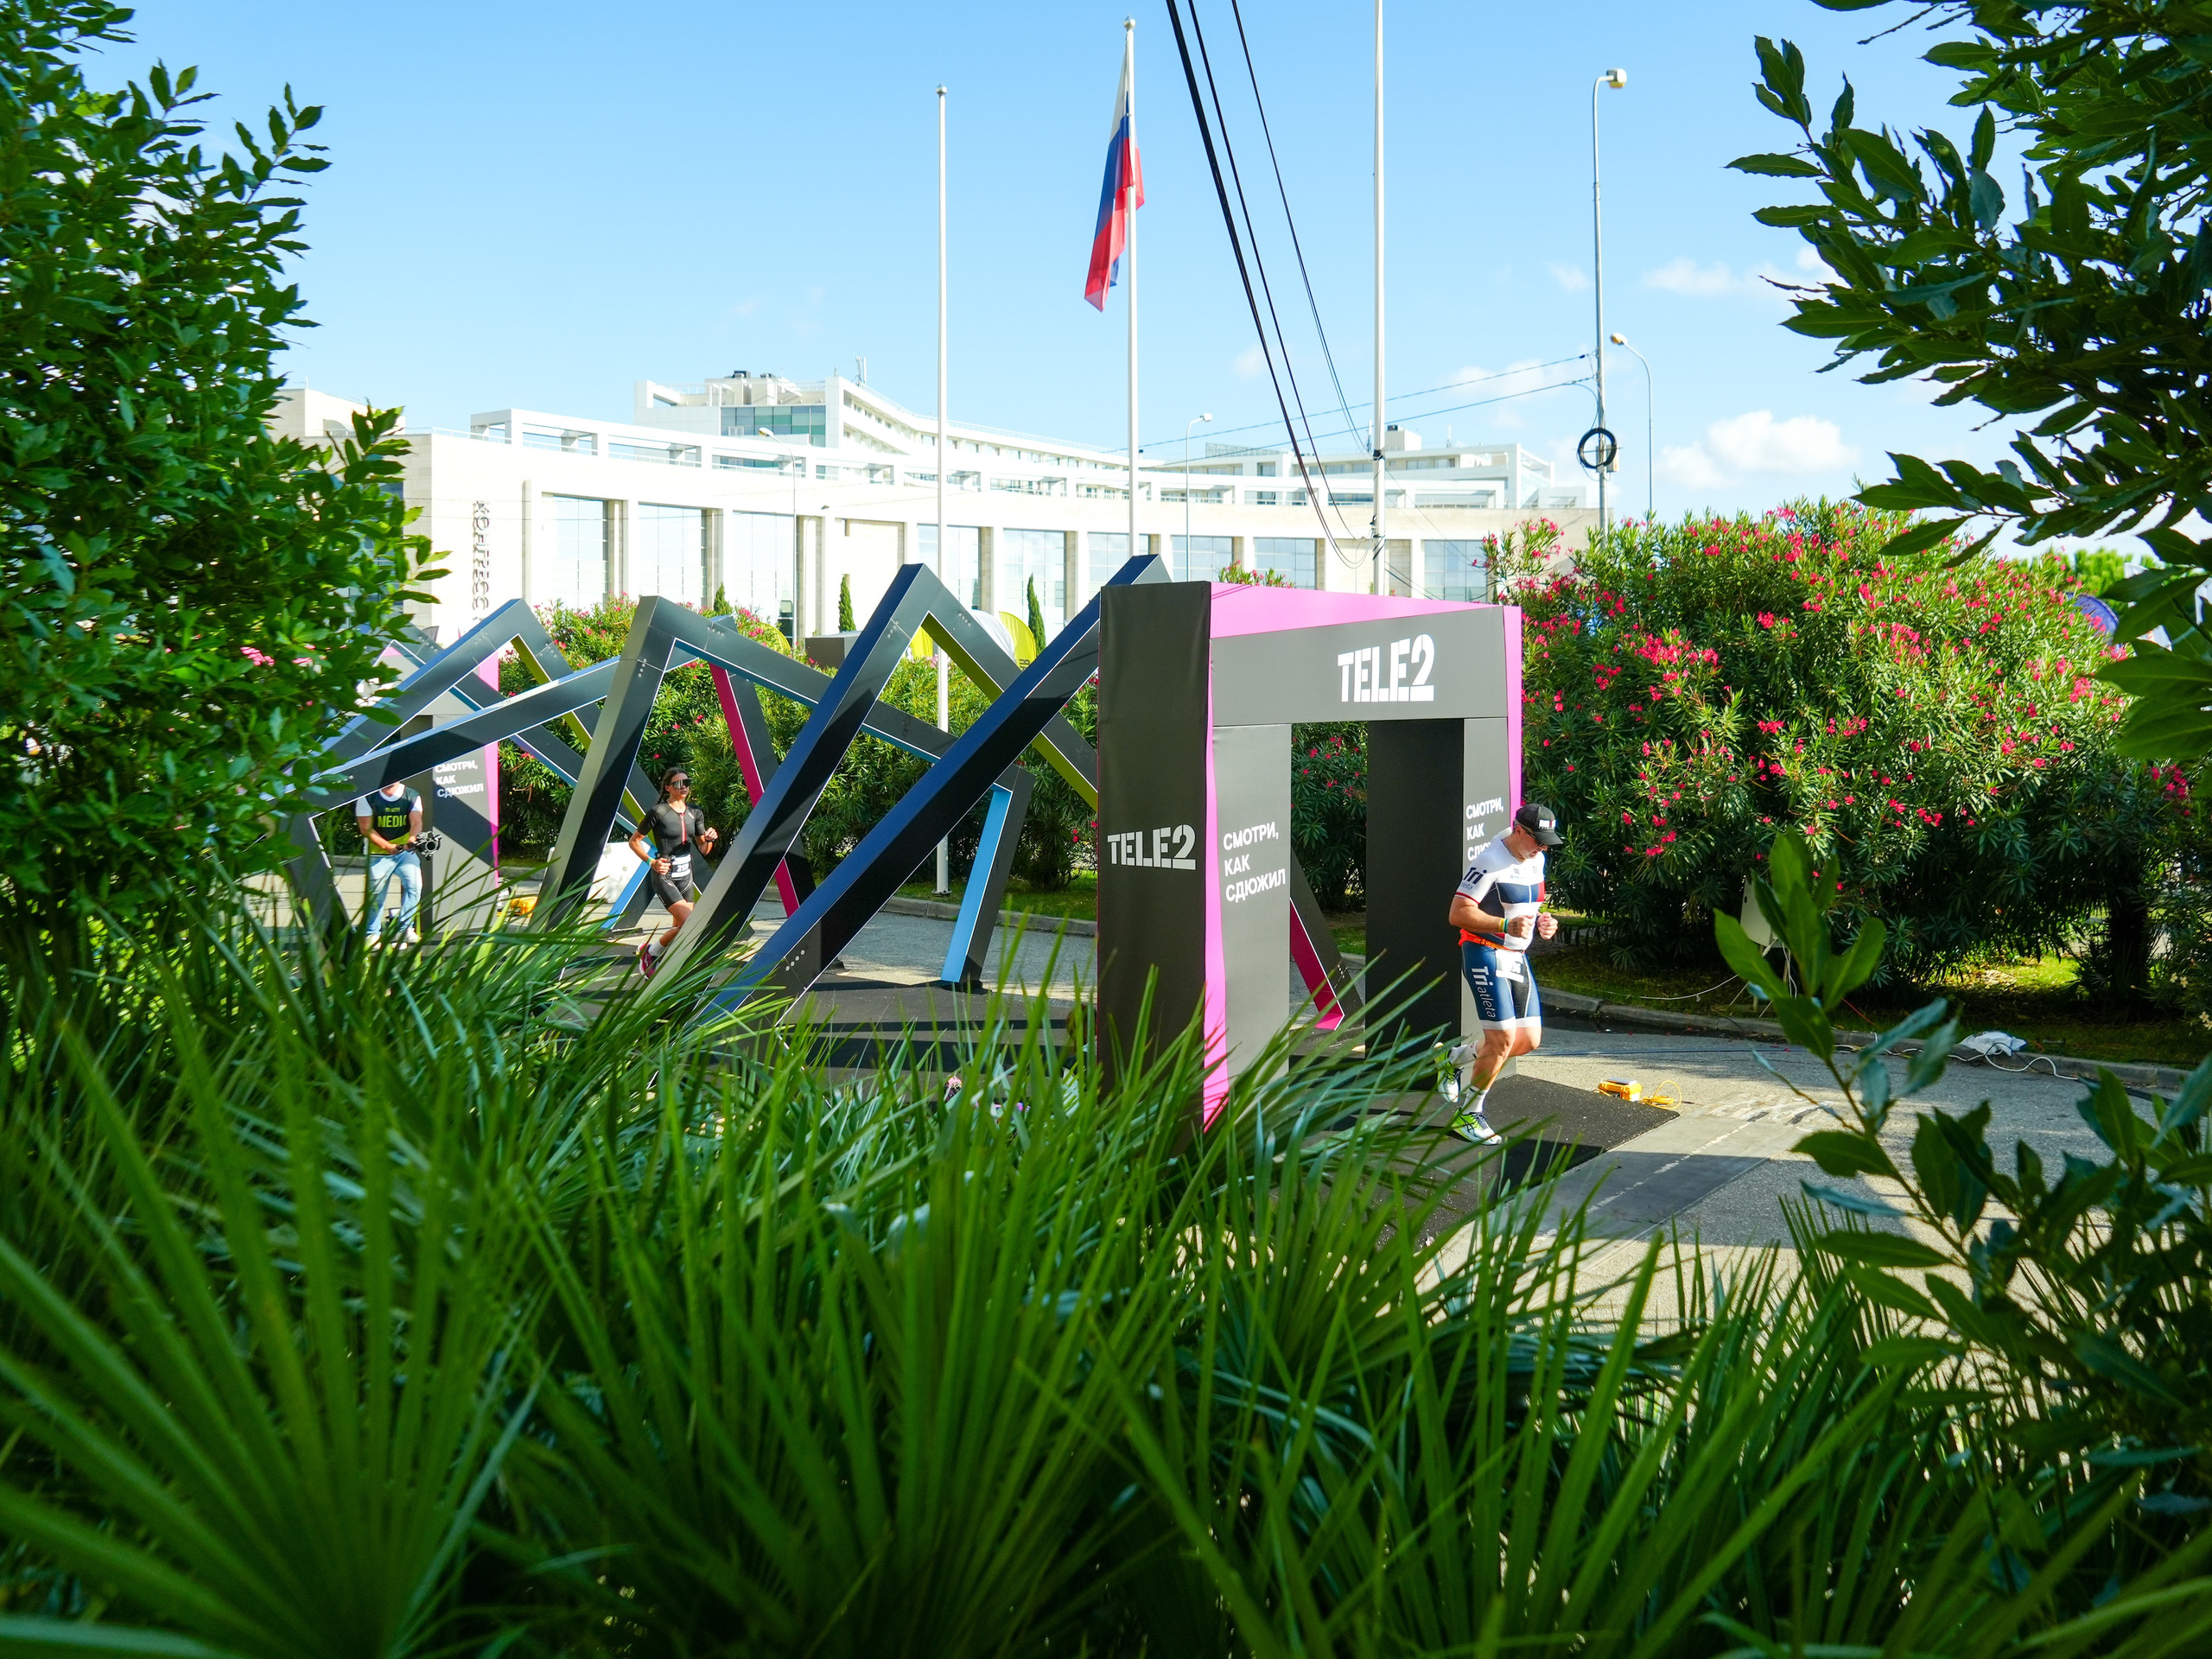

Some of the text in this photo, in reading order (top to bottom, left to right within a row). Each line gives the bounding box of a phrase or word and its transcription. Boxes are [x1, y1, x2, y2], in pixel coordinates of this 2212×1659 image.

[1338, 633, 1435, 702] TELE2
[435, 760, 478, 773] СМОТРИ,
[435, 774, 456, 785] КАК
[437, 783, 484, 798] СДЮЖИЛ
[1465, 797, 1503, 820] СМОТРИ,
[1223, 822, 1279, 850] СМОТРИ,
[1466, 823, 1485, 841] КАК
[1107, 824, 1196, 870] TELE2
[1224, 854, 1251, 877] КАК
[1463, 867, 1488, 885] Tri
[1225, 868, 1286, 903] СДЮЖИЛ
